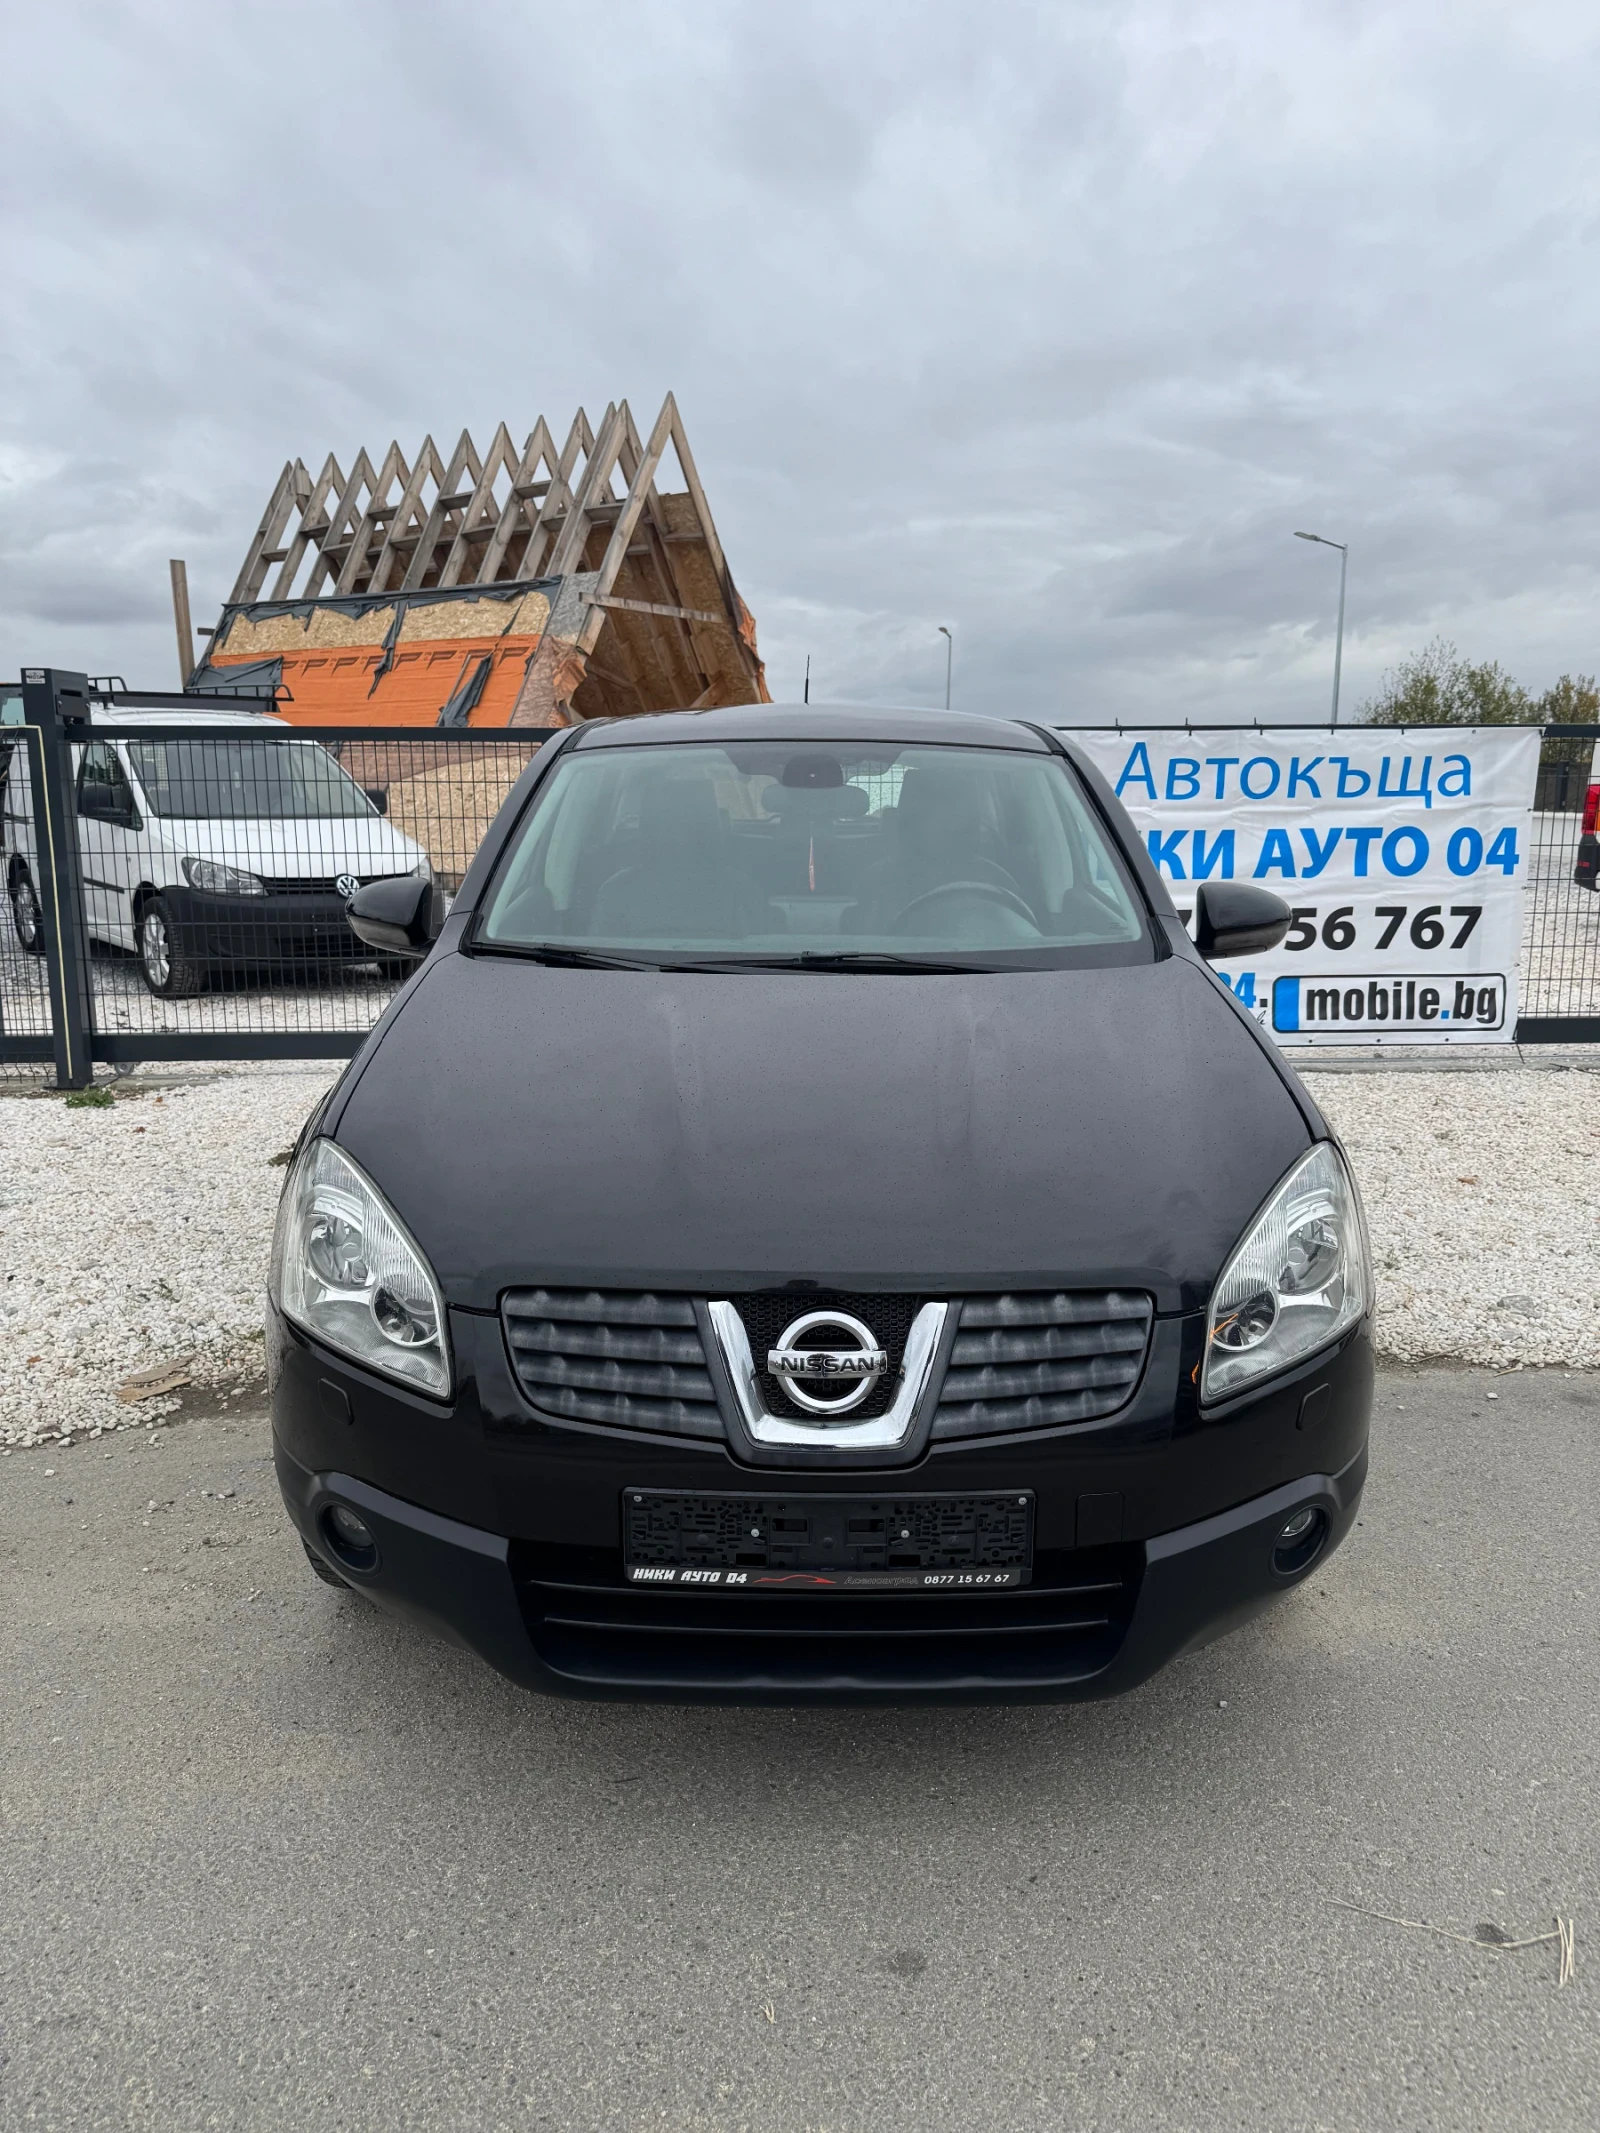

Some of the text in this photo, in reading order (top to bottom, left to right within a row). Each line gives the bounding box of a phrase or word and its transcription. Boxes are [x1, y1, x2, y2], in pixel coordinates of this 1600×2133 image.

[1115, 741, 1471, 808] Автокъща
[1138, 826, 1520, 880] КИ АУТО 04
[1284, 906, 1483, 951] 56 767
[1306, 981, 1497, 1025] mobile.bg
[780, 1356, 875, 1373] NISSAN
[633, 1568, 676, 1581] НИКИ
[680, 1570, 722, 1583] АУТО
[725, 1572, 748, 1584] 04
[924, 1575, 955, 1584] 0877
[957, 1574, 973, 1584] 15
[975, 1574, 991, 1583] 67
[994, 1573, 1010, 1583] 67
